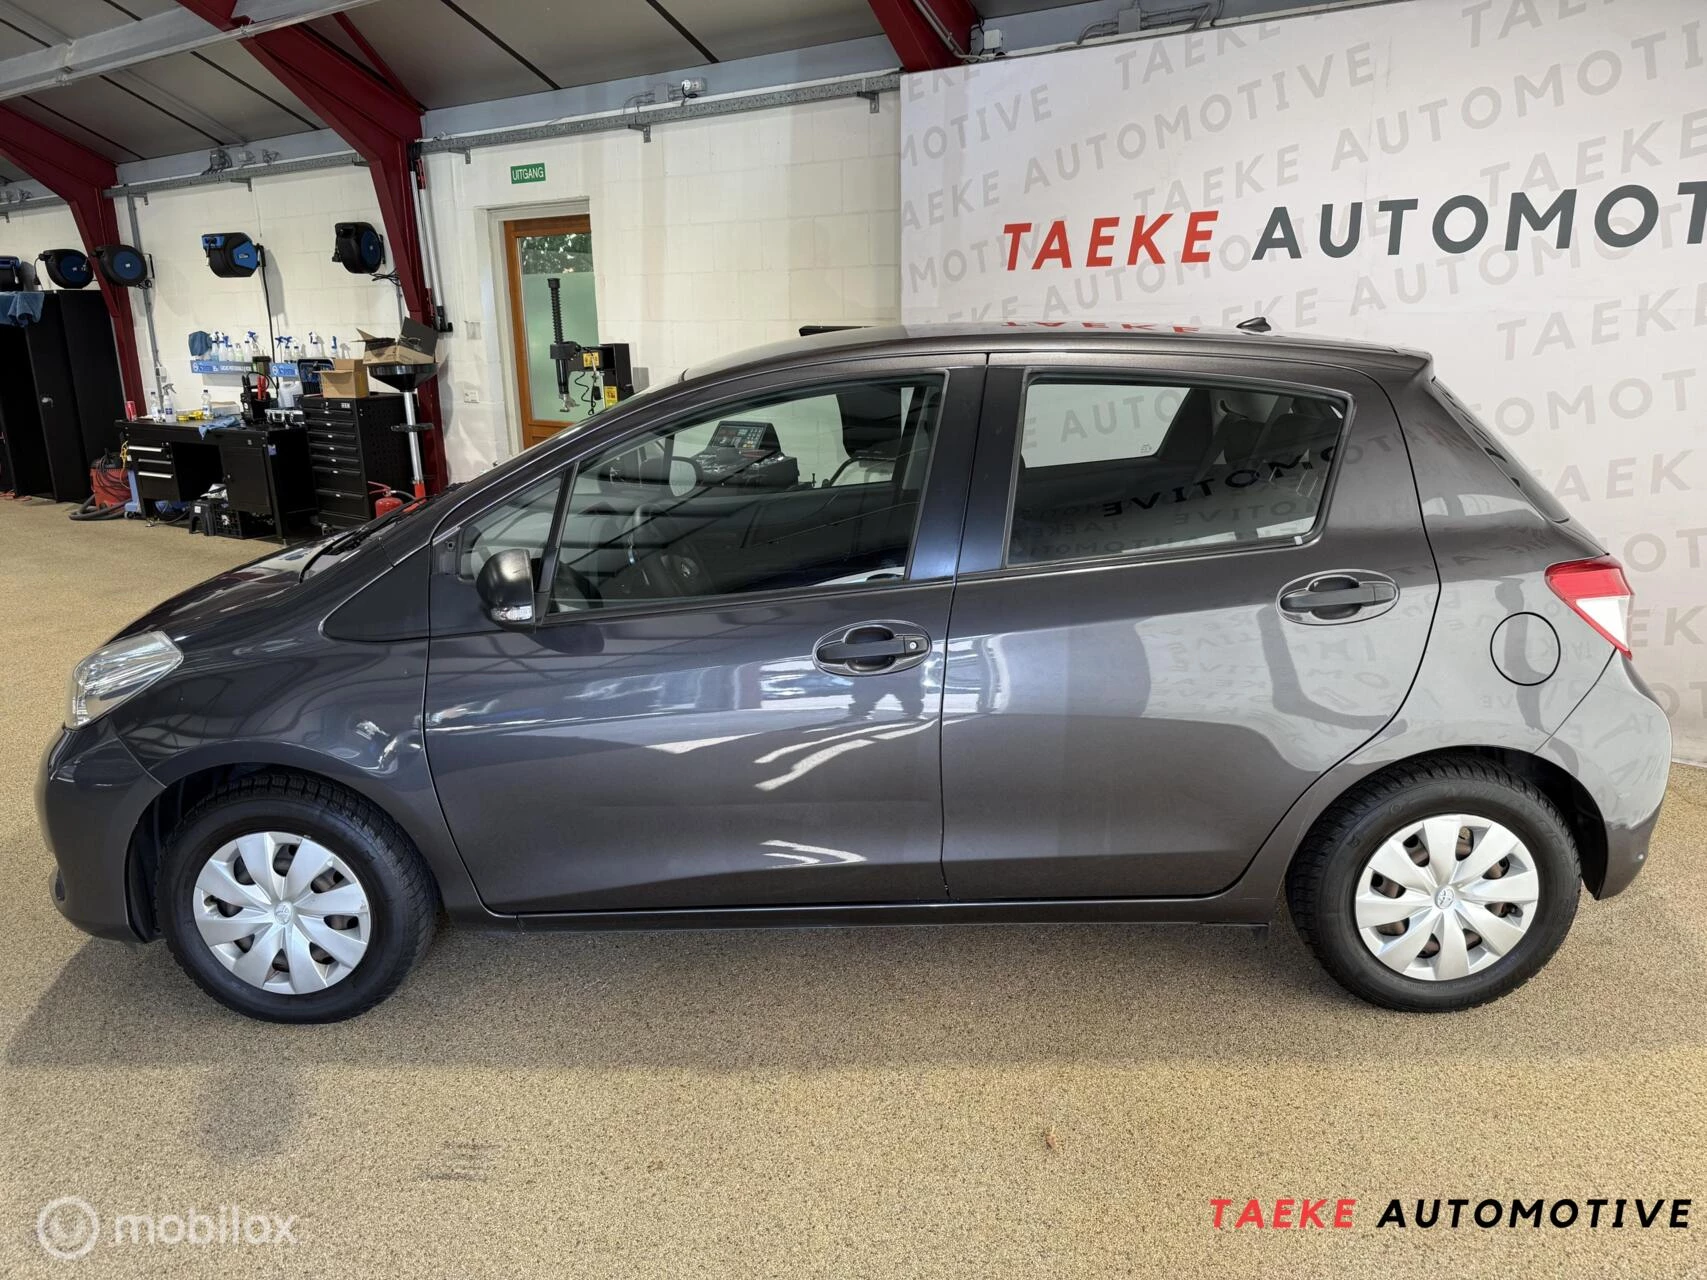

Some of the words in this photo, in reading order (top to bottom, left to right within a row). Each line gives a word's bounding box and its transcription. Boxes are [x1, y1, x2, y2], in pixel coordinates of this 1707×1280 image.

[1024, 40, 1375, 194] AUTOMOTIVE
[512, 166, 545, 181] UITGANG
[1004, 210, 1220, 272] TAEKE
[1251, 180, 1707, 262] AUTOMOT
[1470, 368, 1697, 436] OMOT
[1536, 449, 1695, 502] AEK
